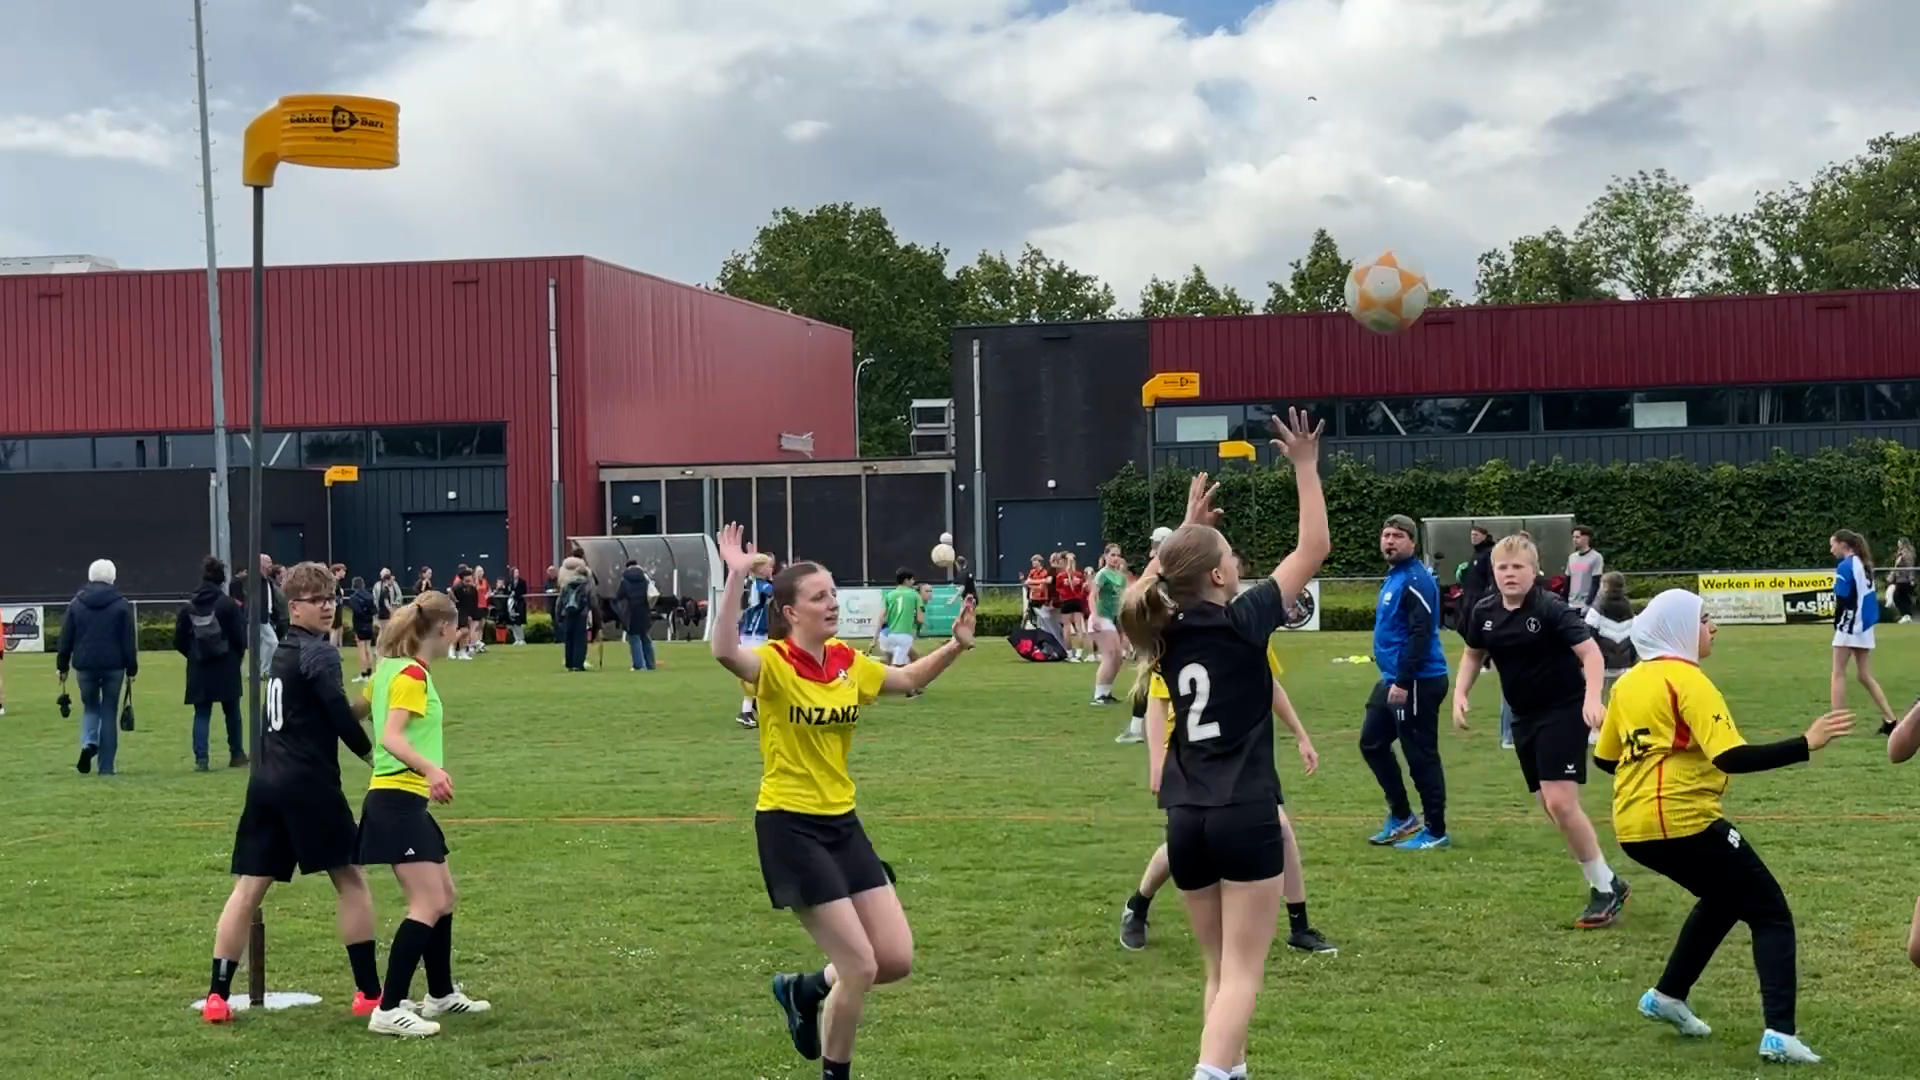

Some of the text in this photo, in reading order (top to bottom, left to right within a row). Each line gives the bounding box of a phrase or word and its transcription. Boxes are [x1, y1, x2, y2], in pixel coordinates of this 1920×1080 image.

[1702, 576, 1834, 590] Werken in de haven?
[1178, 662, 1221, 742] 2
